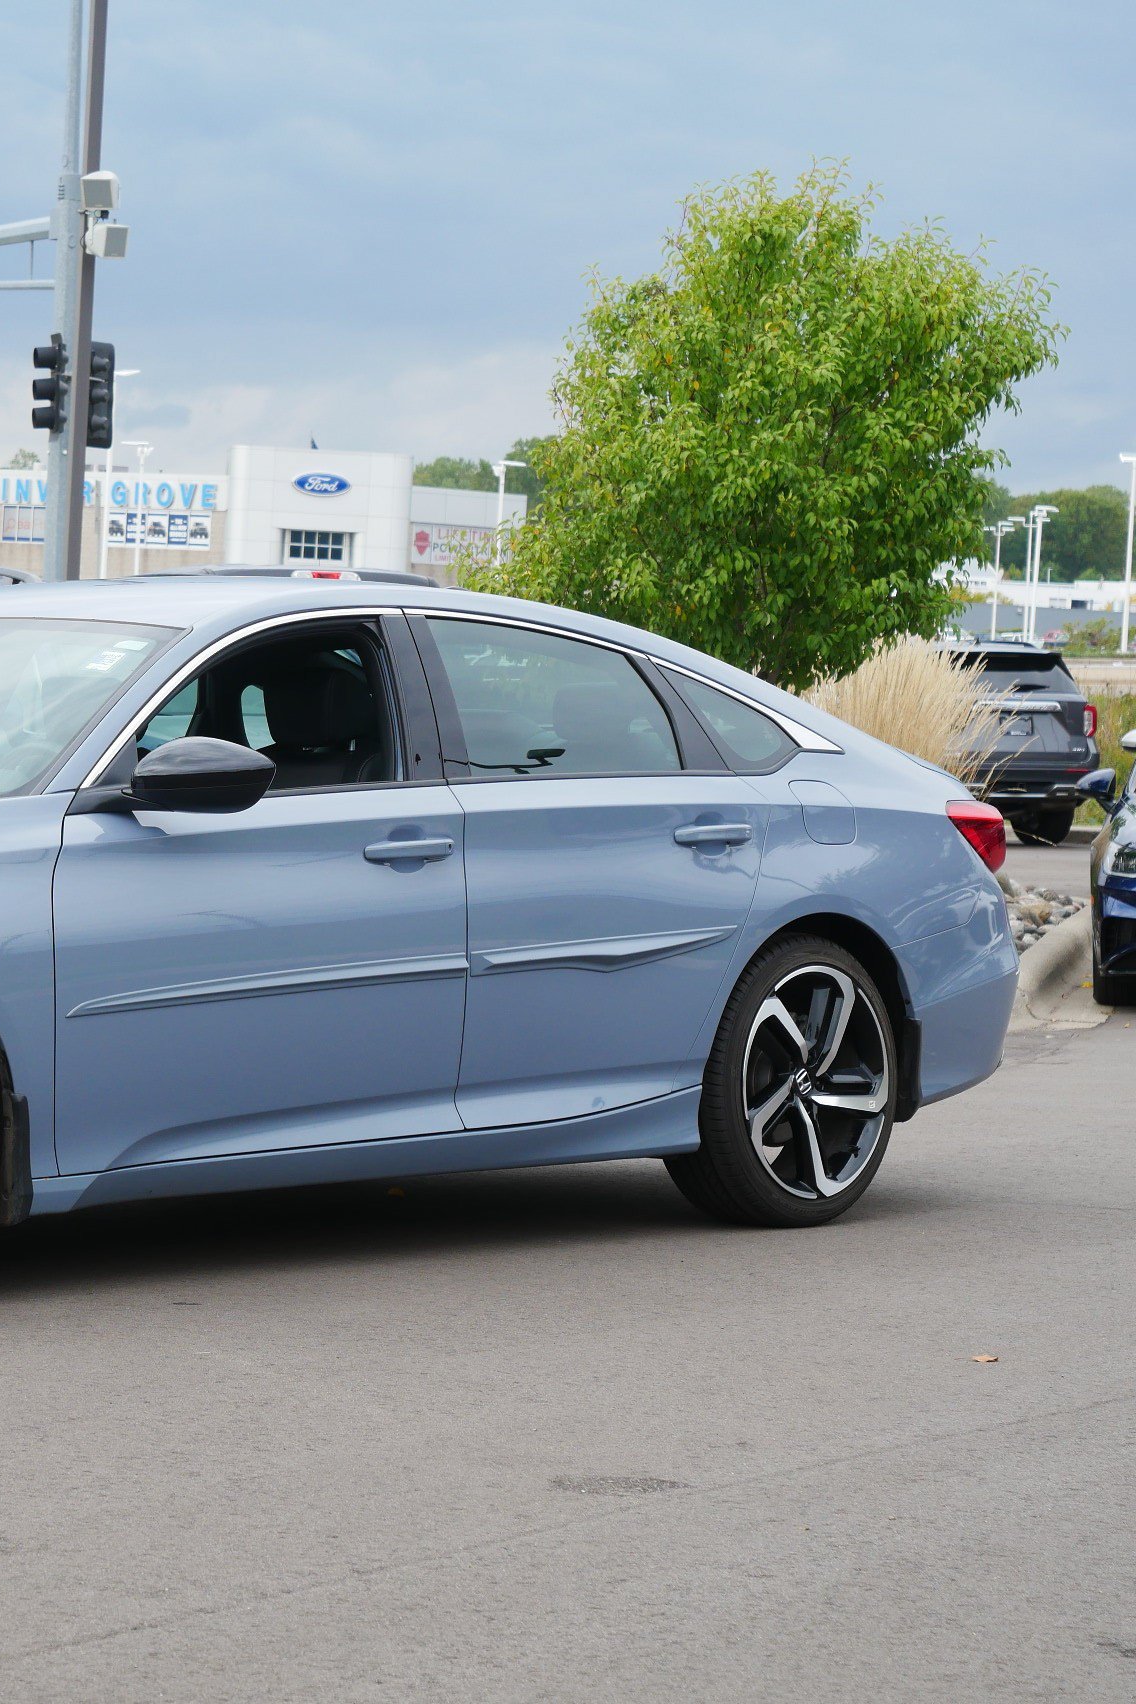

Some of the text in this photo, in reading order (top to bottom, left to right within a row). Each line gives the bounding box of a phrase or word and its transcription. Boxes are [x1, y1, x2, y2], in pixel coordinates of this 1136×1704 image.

[1, 478, 218, 509] INVR GROVE
[304, 476, 339, 493] Ford
